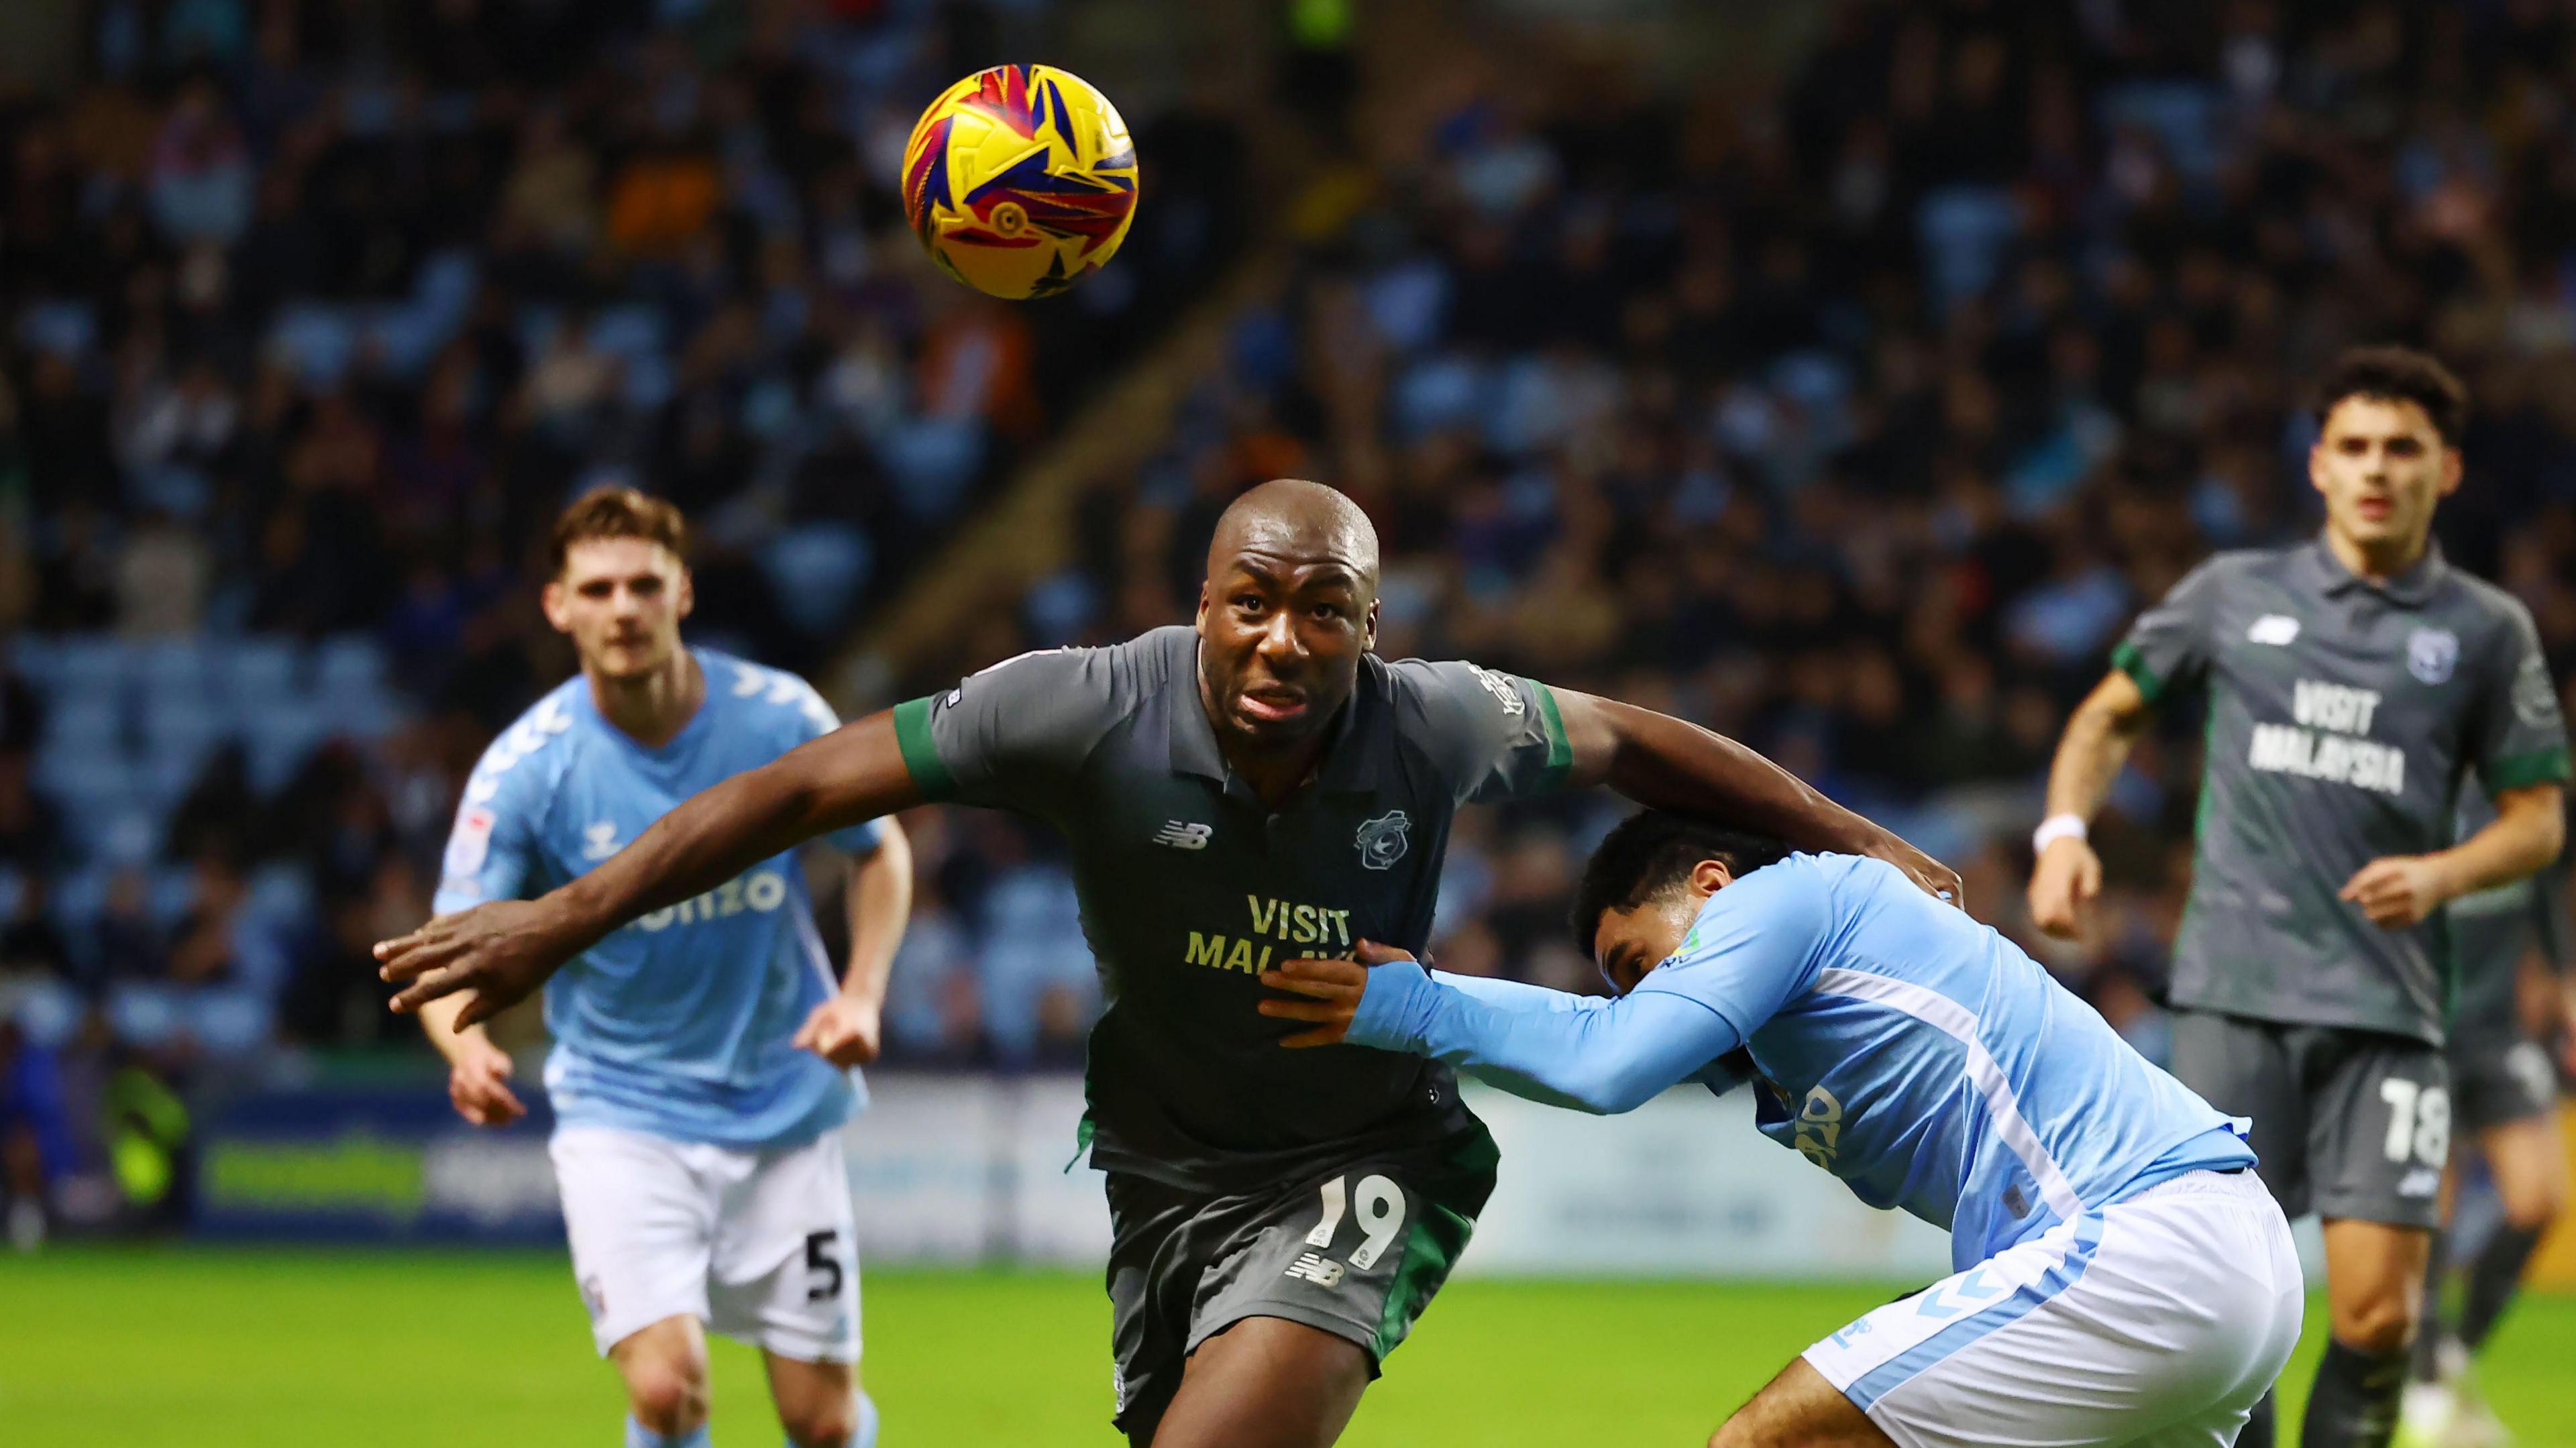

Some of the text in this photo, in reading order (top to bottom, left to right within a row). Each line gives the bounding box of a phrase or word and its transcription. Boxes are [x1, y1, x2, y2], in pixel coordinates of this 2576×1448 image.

[2294, 677, 2383, 736] VISIT
[2249, 721, 2406, 796] MALAYSIA
[1247, 894, 1350, 947] VISIT
[2380, 1078, 2451, 1170] 18
[1305, 1174, 1406, 1271] 19
[805, 1230, 843, 1300] 5
